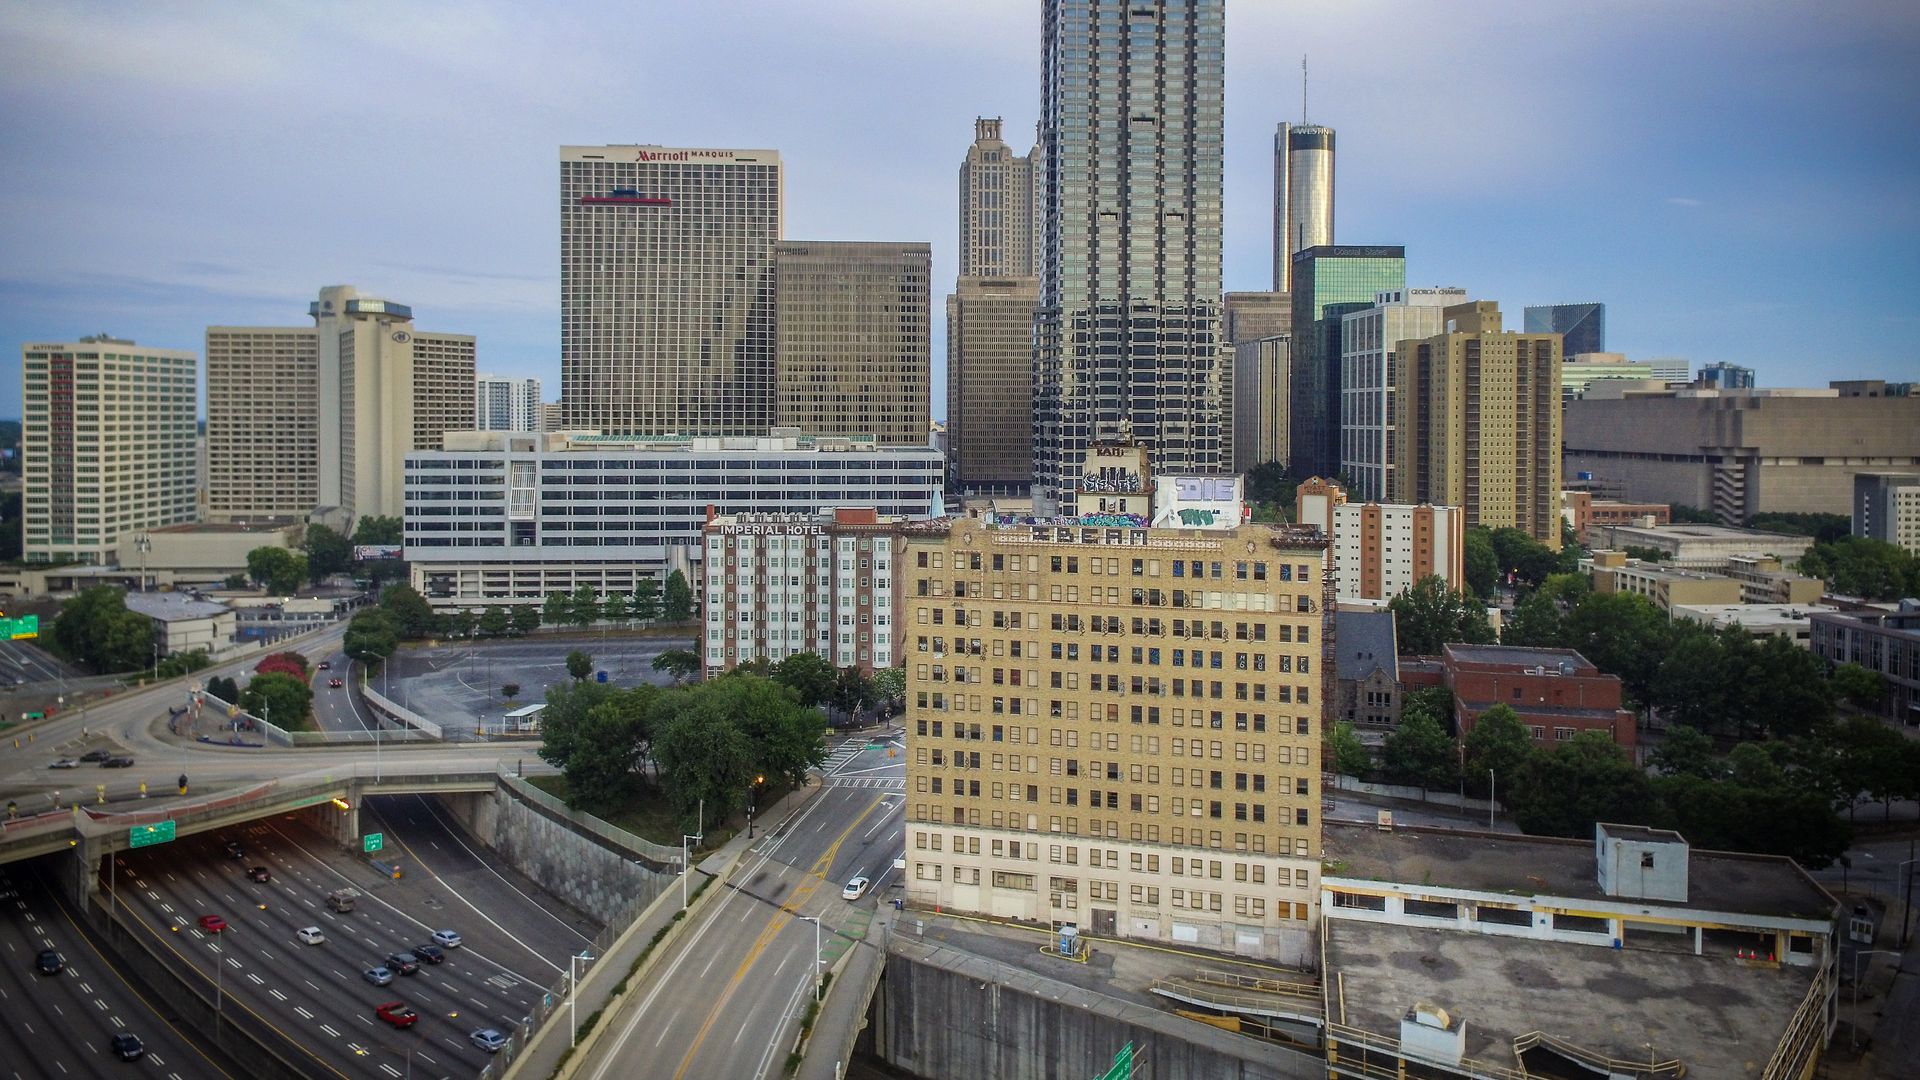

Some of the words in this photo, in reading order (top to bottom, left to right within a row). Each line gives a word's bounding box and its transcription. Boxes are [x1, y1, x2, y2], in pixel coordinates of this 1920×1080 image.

[636, 150, 689, 162] Marriott
[691, 150, 734, 159] MARQUIS
[1333, 247, 1361, 256] Coastal
[1364, 247, 1388, 256] States
[1410, 288, 1437, 296] GEORGIA
[1438, 288, 1467, 296] CHAMBER
[720, 524, 783, 536] IMPERIAL
[786, 524, 826, 536] HOTEL
